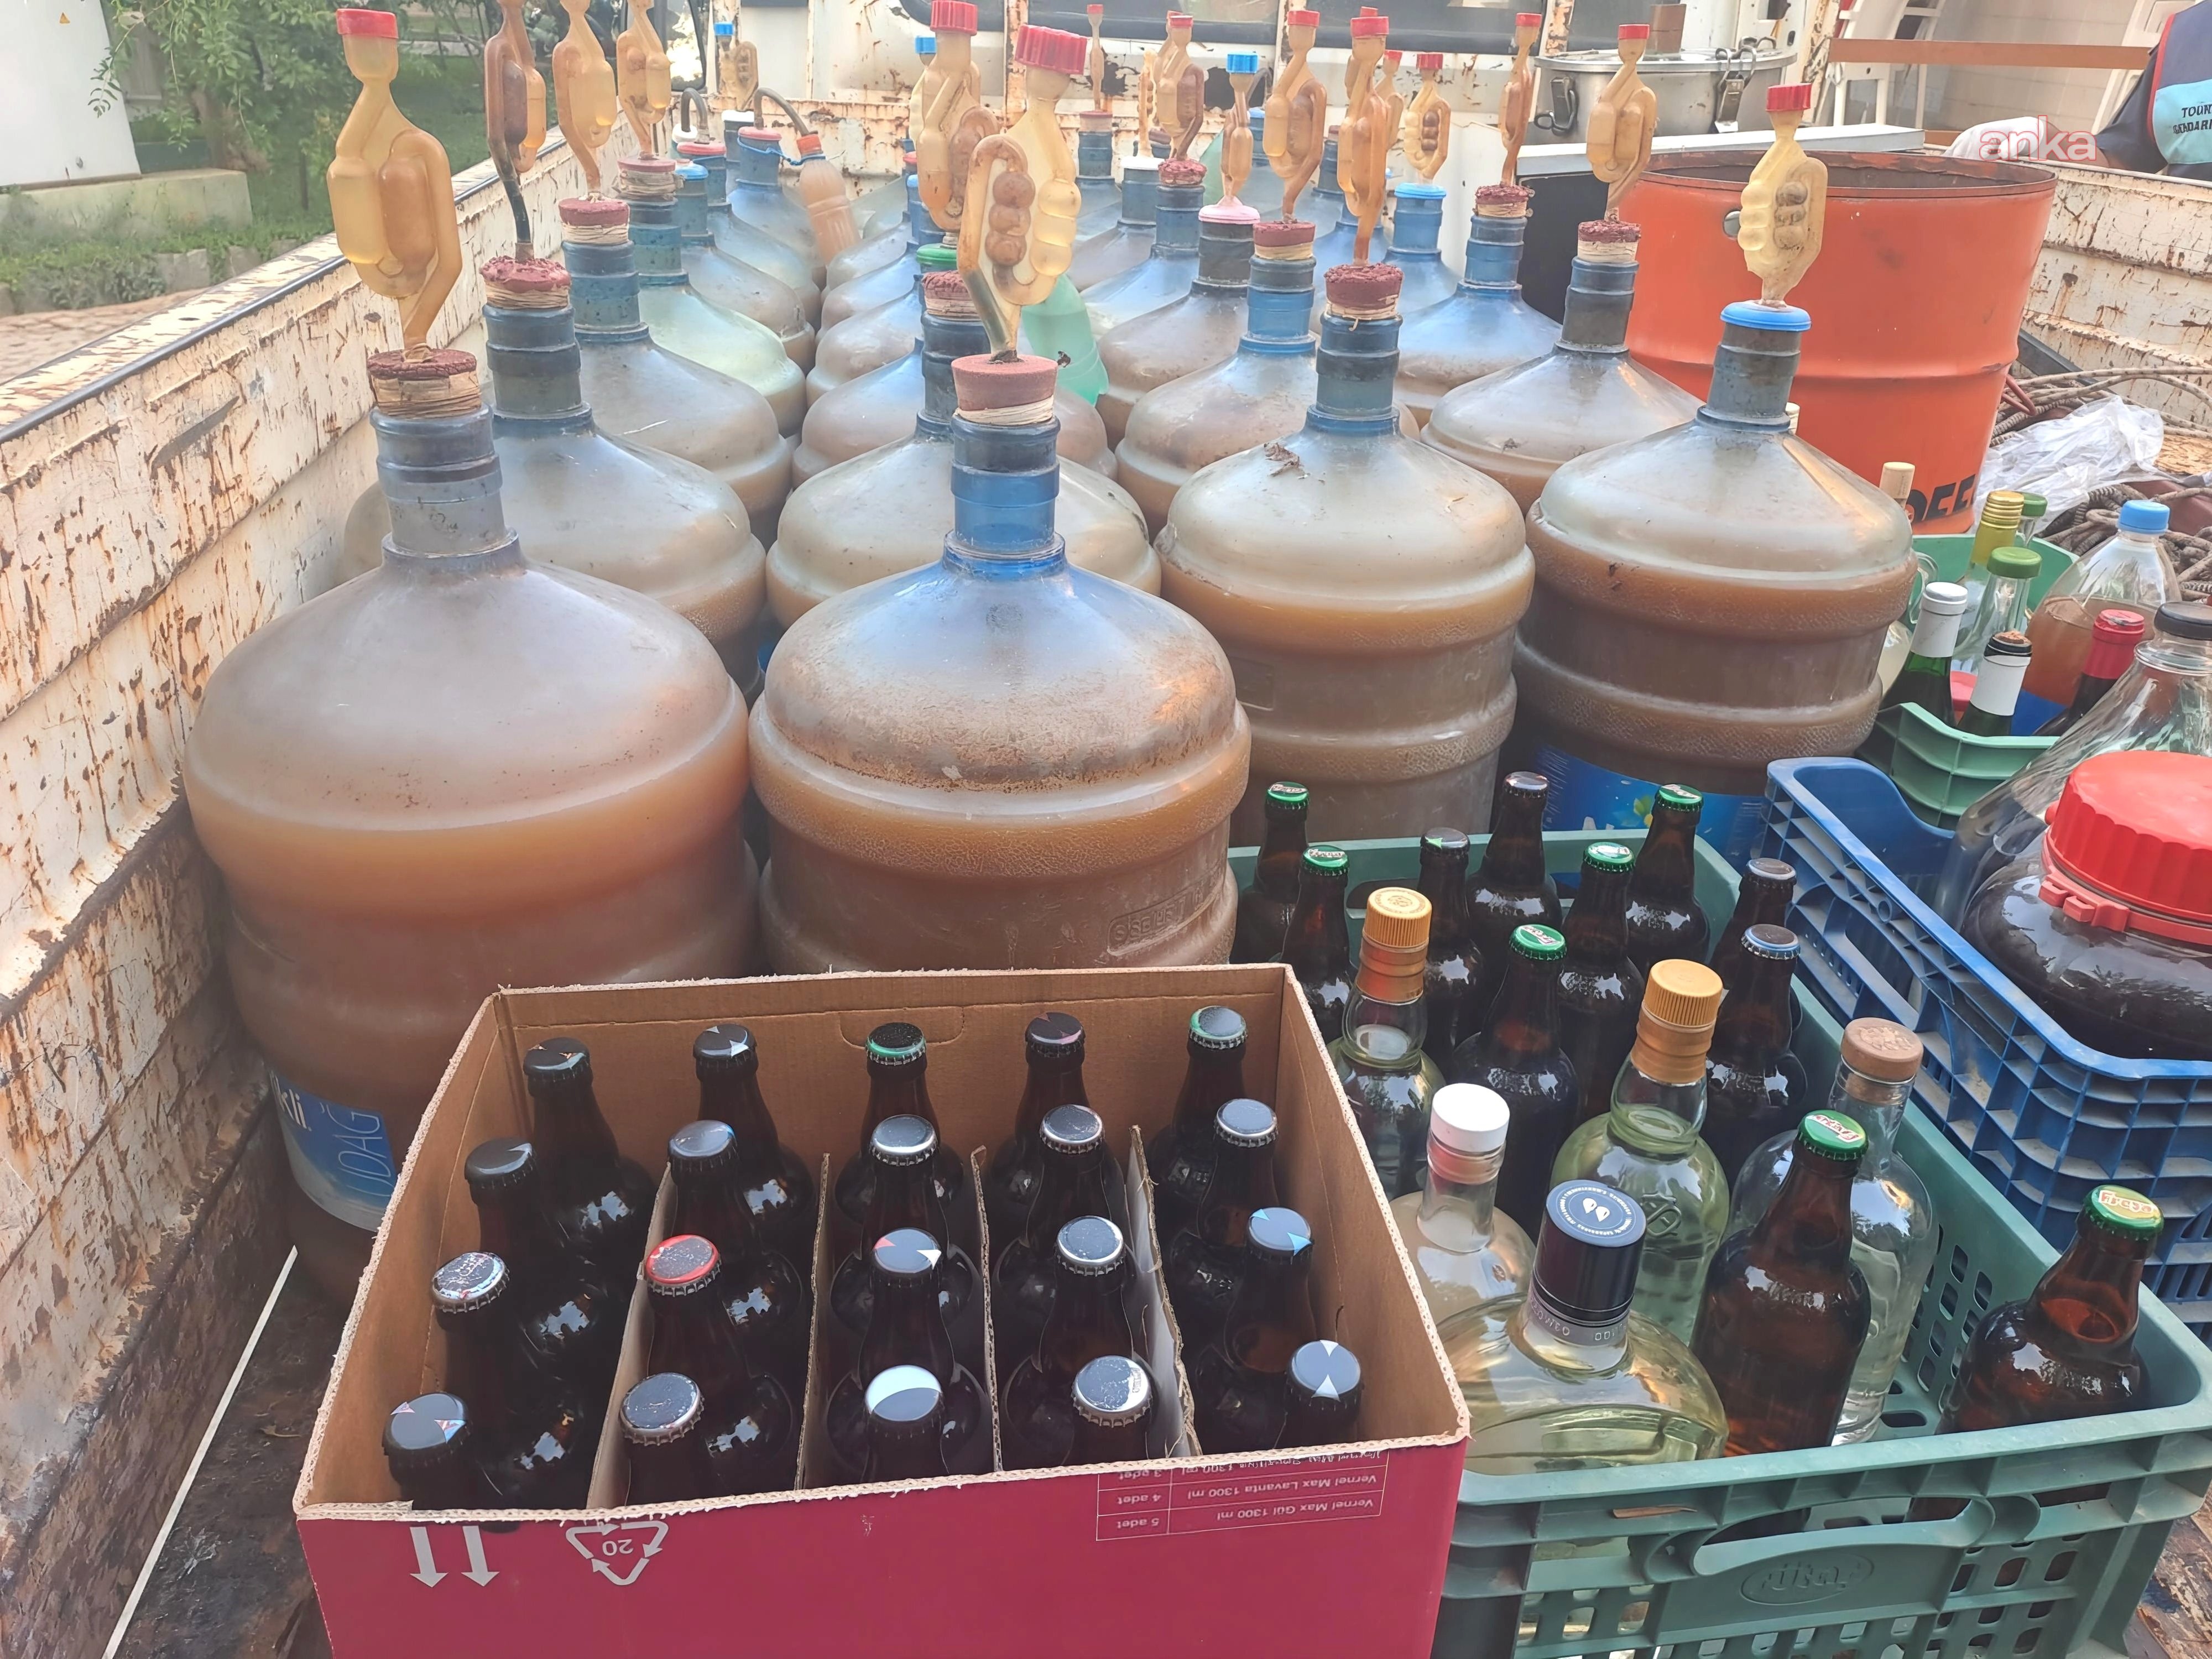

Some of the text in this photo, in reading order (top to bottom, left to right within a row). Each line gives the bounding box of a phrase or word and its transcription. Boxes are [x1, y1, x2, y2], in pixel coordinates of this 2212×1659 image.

[1187, 1475, 1377, 1499] Vernel Max Lavanta 1300 ml
[1117, 1494, 1149, 1505] adet
[1332, 1499, 1374, 1510] Vernel
[1300, 1503, 1328, 1511] Max
[1217, 1510, 1234, 1521] ml
[1237, 1509, 1269, 1519] 1300
[1117, 1518, 1160, 1528] 5 adet
[602, 1538, 634, 1556] 20
